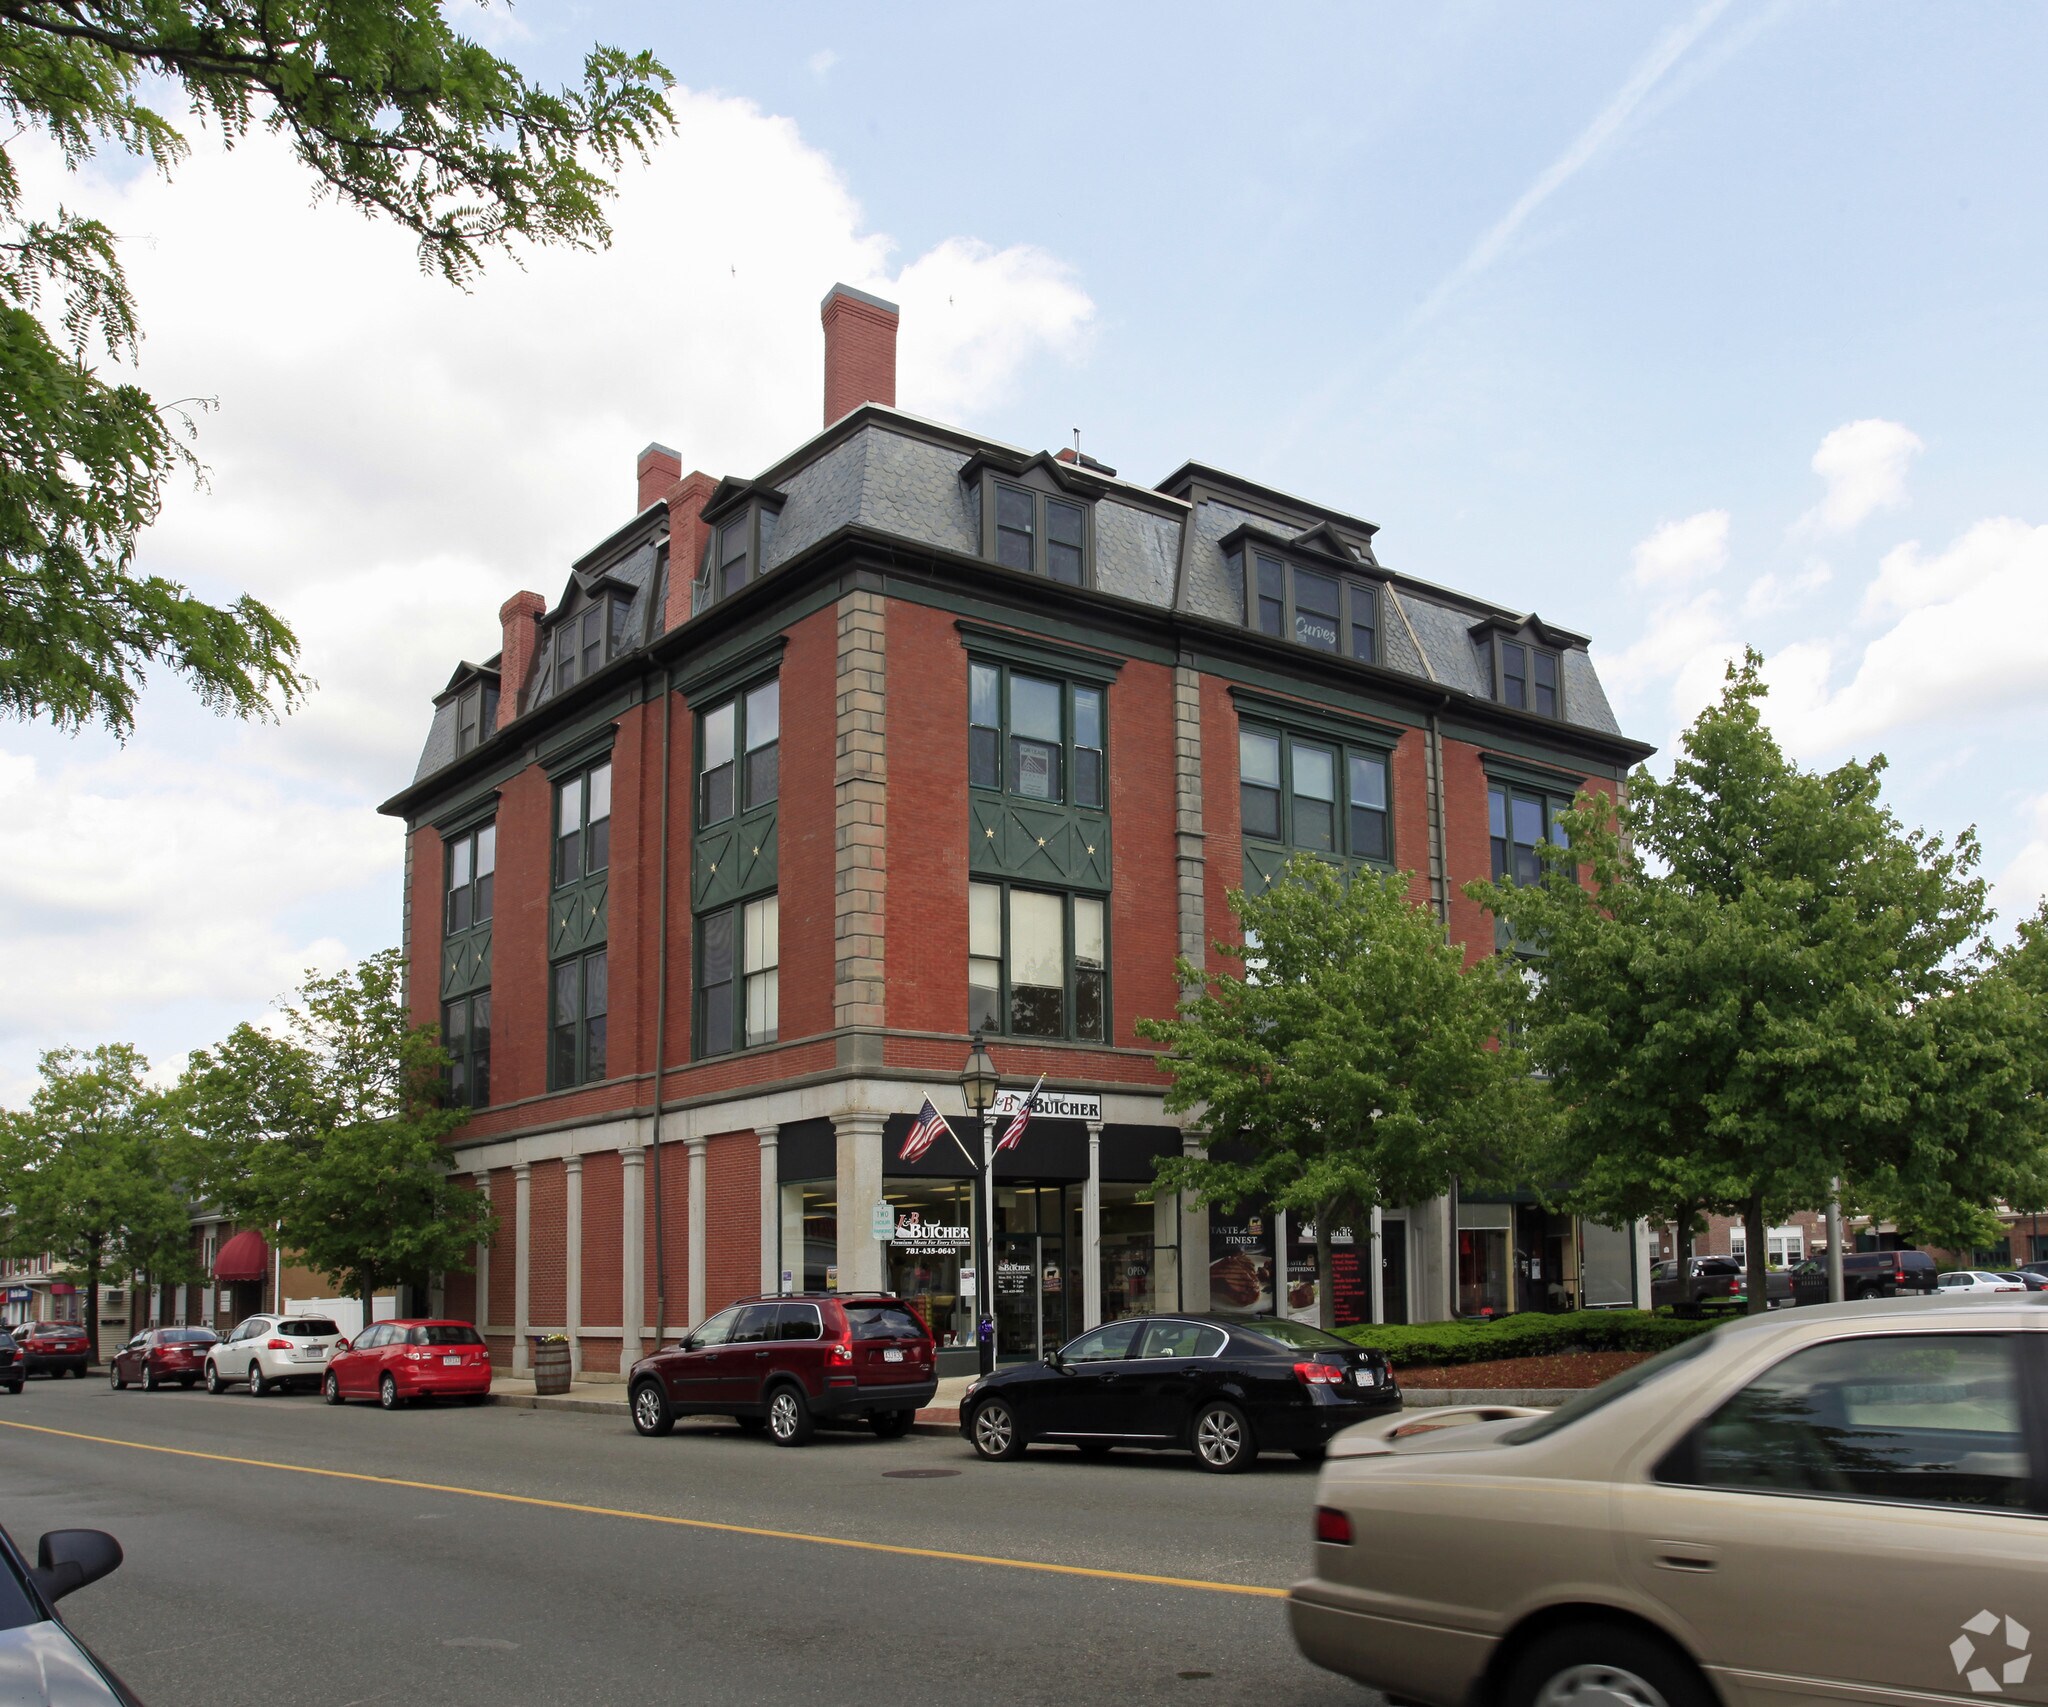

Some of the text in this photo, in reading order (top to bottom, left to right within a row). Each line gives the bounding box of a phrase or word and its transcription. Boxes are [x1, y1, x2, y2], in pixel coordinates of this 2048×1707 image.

[1295, 616, 1336, 644] Curves
[1032, 1098, 1099, 1116] BUTCHER
[910, 1221, 970, 1239] BUTCHER
[1211, 1226, 1238, 1235] TASTE
[1225, 1236, 1258, 1245] FINEST
[905, 1247, 956, 1255] 781-435-0643
[1127, 1266, 1146, 1277] OPEN
